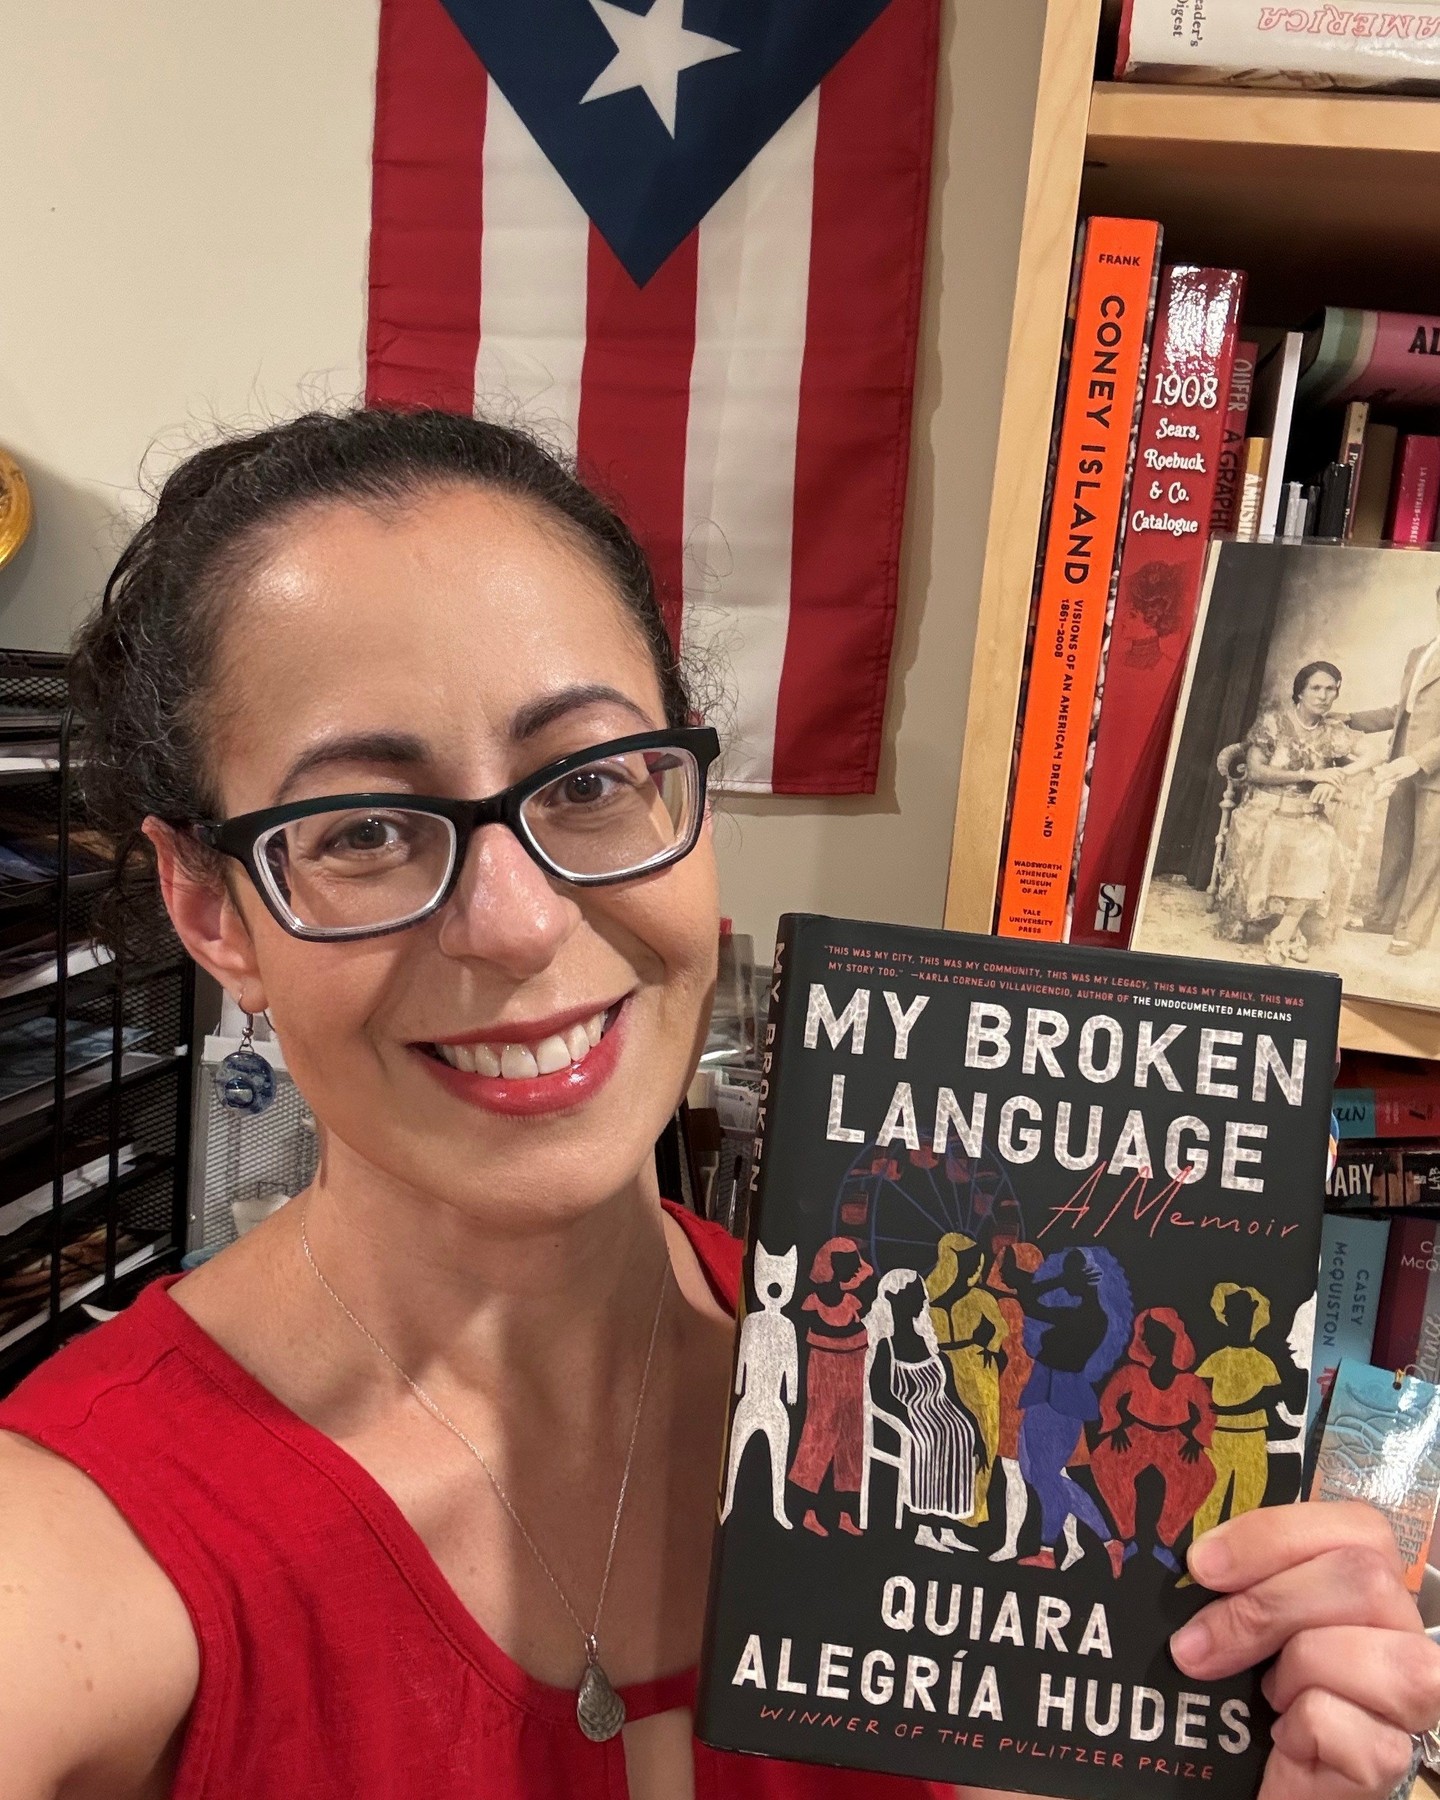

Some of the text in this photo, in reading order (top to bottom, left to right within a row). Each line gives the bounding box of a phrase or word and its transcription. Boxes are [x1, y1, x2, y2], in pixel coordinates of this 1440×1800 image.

[1098, 253, 1140, 267] FRANK
[1151, 372, 1218, 409] 1908
[1064, 295, 1125, 585] CONEY ISLAND
[1155, 417, 1200, 441] Sears,
[1223, 428, 1241, 444] A
[1143, 448, 1206, 473] Roebuck
[1149, 480, 1190, 504] & Co.
[1210, 453, 1238, 532] GRAPHI
[1132, 509, 1198, 537] Catalogue
[1068, 600, 1084, 652] VISIONS
[1066, 654, 1076, 671] OF
[1062, 673, 1074, 692] AN
[1053, 695, 1070, 760] AMERICAN
[1014, 860, 1062, 870] WADSWORTH
[1016, 869, 1058, 879] ATHENEUM
[1020, 879, 1052, 887] MUSEUM
[1009, 916, 1053, 926] UNIVERSITY
[1023, 908, 1041, 916] YALE
[1018, 926, 1041, 934] PRESS
[771, 942, 786, 1003] MY
[853, 949, 871, 958] WAS
[875, 951, 888, 960] MY
[920, 956, 940, 966] THIS
[944, 959, 962, 968] WAS
[966, 961, 980, 970] MY
[983, 962, 1043, 978] COMMUNITY,
[1047, 970, 1068, 981] THIS
[1071, 973, 1090, 983] WAS
[1094, 975, 1108, 985] MY
[1112, 977, 1150, 990] LEGACY,
[1154, 982, 1175, 993] THIS
[1179, 985, 1198, 995] WAS
[1202, 987, 1216, 997] MY
[1260, 993, 1281, 1005] THIS
[1285, 997, 1304, 1007] WAS
[828, 962, 842, 971] MY
[846, 964, 874, 975] STORY
[953, 976, 996, 988] CORNEJO
[1000, 980, 1073, 998] VILLAVICENCIO,
[1076, 990, 1113, 1001] AUTHOR
[1117, 994, 1129, 1003] OF
[1133, 995, 1151, 1006] THE
[1154, 998, 1233, 1015] UNDOCUMENTED
[1236, 1007, 1292, 1022] AMERICANS
[803, 983, 1307, 1107] MY BROKEN
[1333, 1105, 1365, 1122] UN
[826, 1074, 1268, 1193] LANGUAGE
[1037, 1161, 1299, 1238] A Memoir
[1351, 1269, 1369, 1326] CASEY
[880, 1575, 1113, 1659] QUIARA
[730, 1634, 1252, 1756] ALEGRÍA HUDES
[760, 1704, 1214, 1780] WINNER OF THE PULITZER PRIZE
